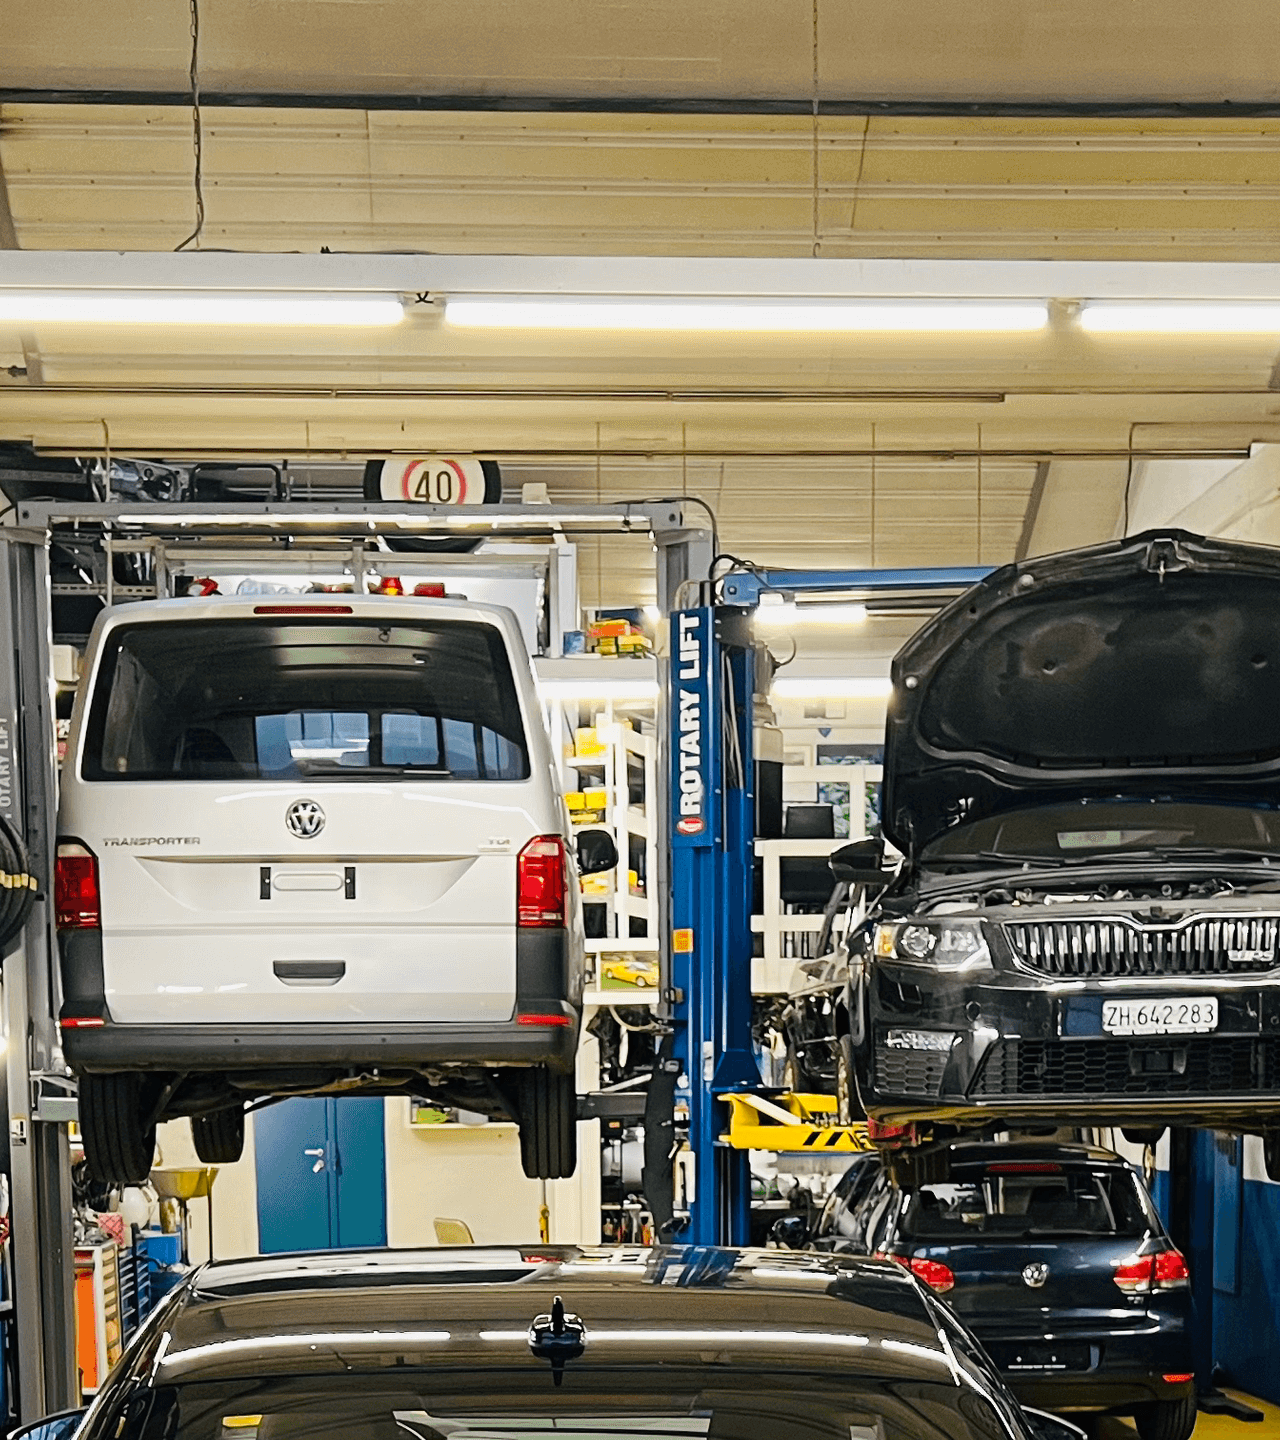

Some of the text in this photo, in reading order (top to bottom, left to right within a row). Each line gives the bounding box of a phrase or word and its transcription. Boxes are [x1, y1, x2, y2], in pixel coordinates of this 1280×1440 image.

[414, 470, 452, 502] 40
[679, 613, 701, 680] LIFT
[679, 688, 702, 816] ROTARY
[102, 836, 201, 847] TRANSPORTER
